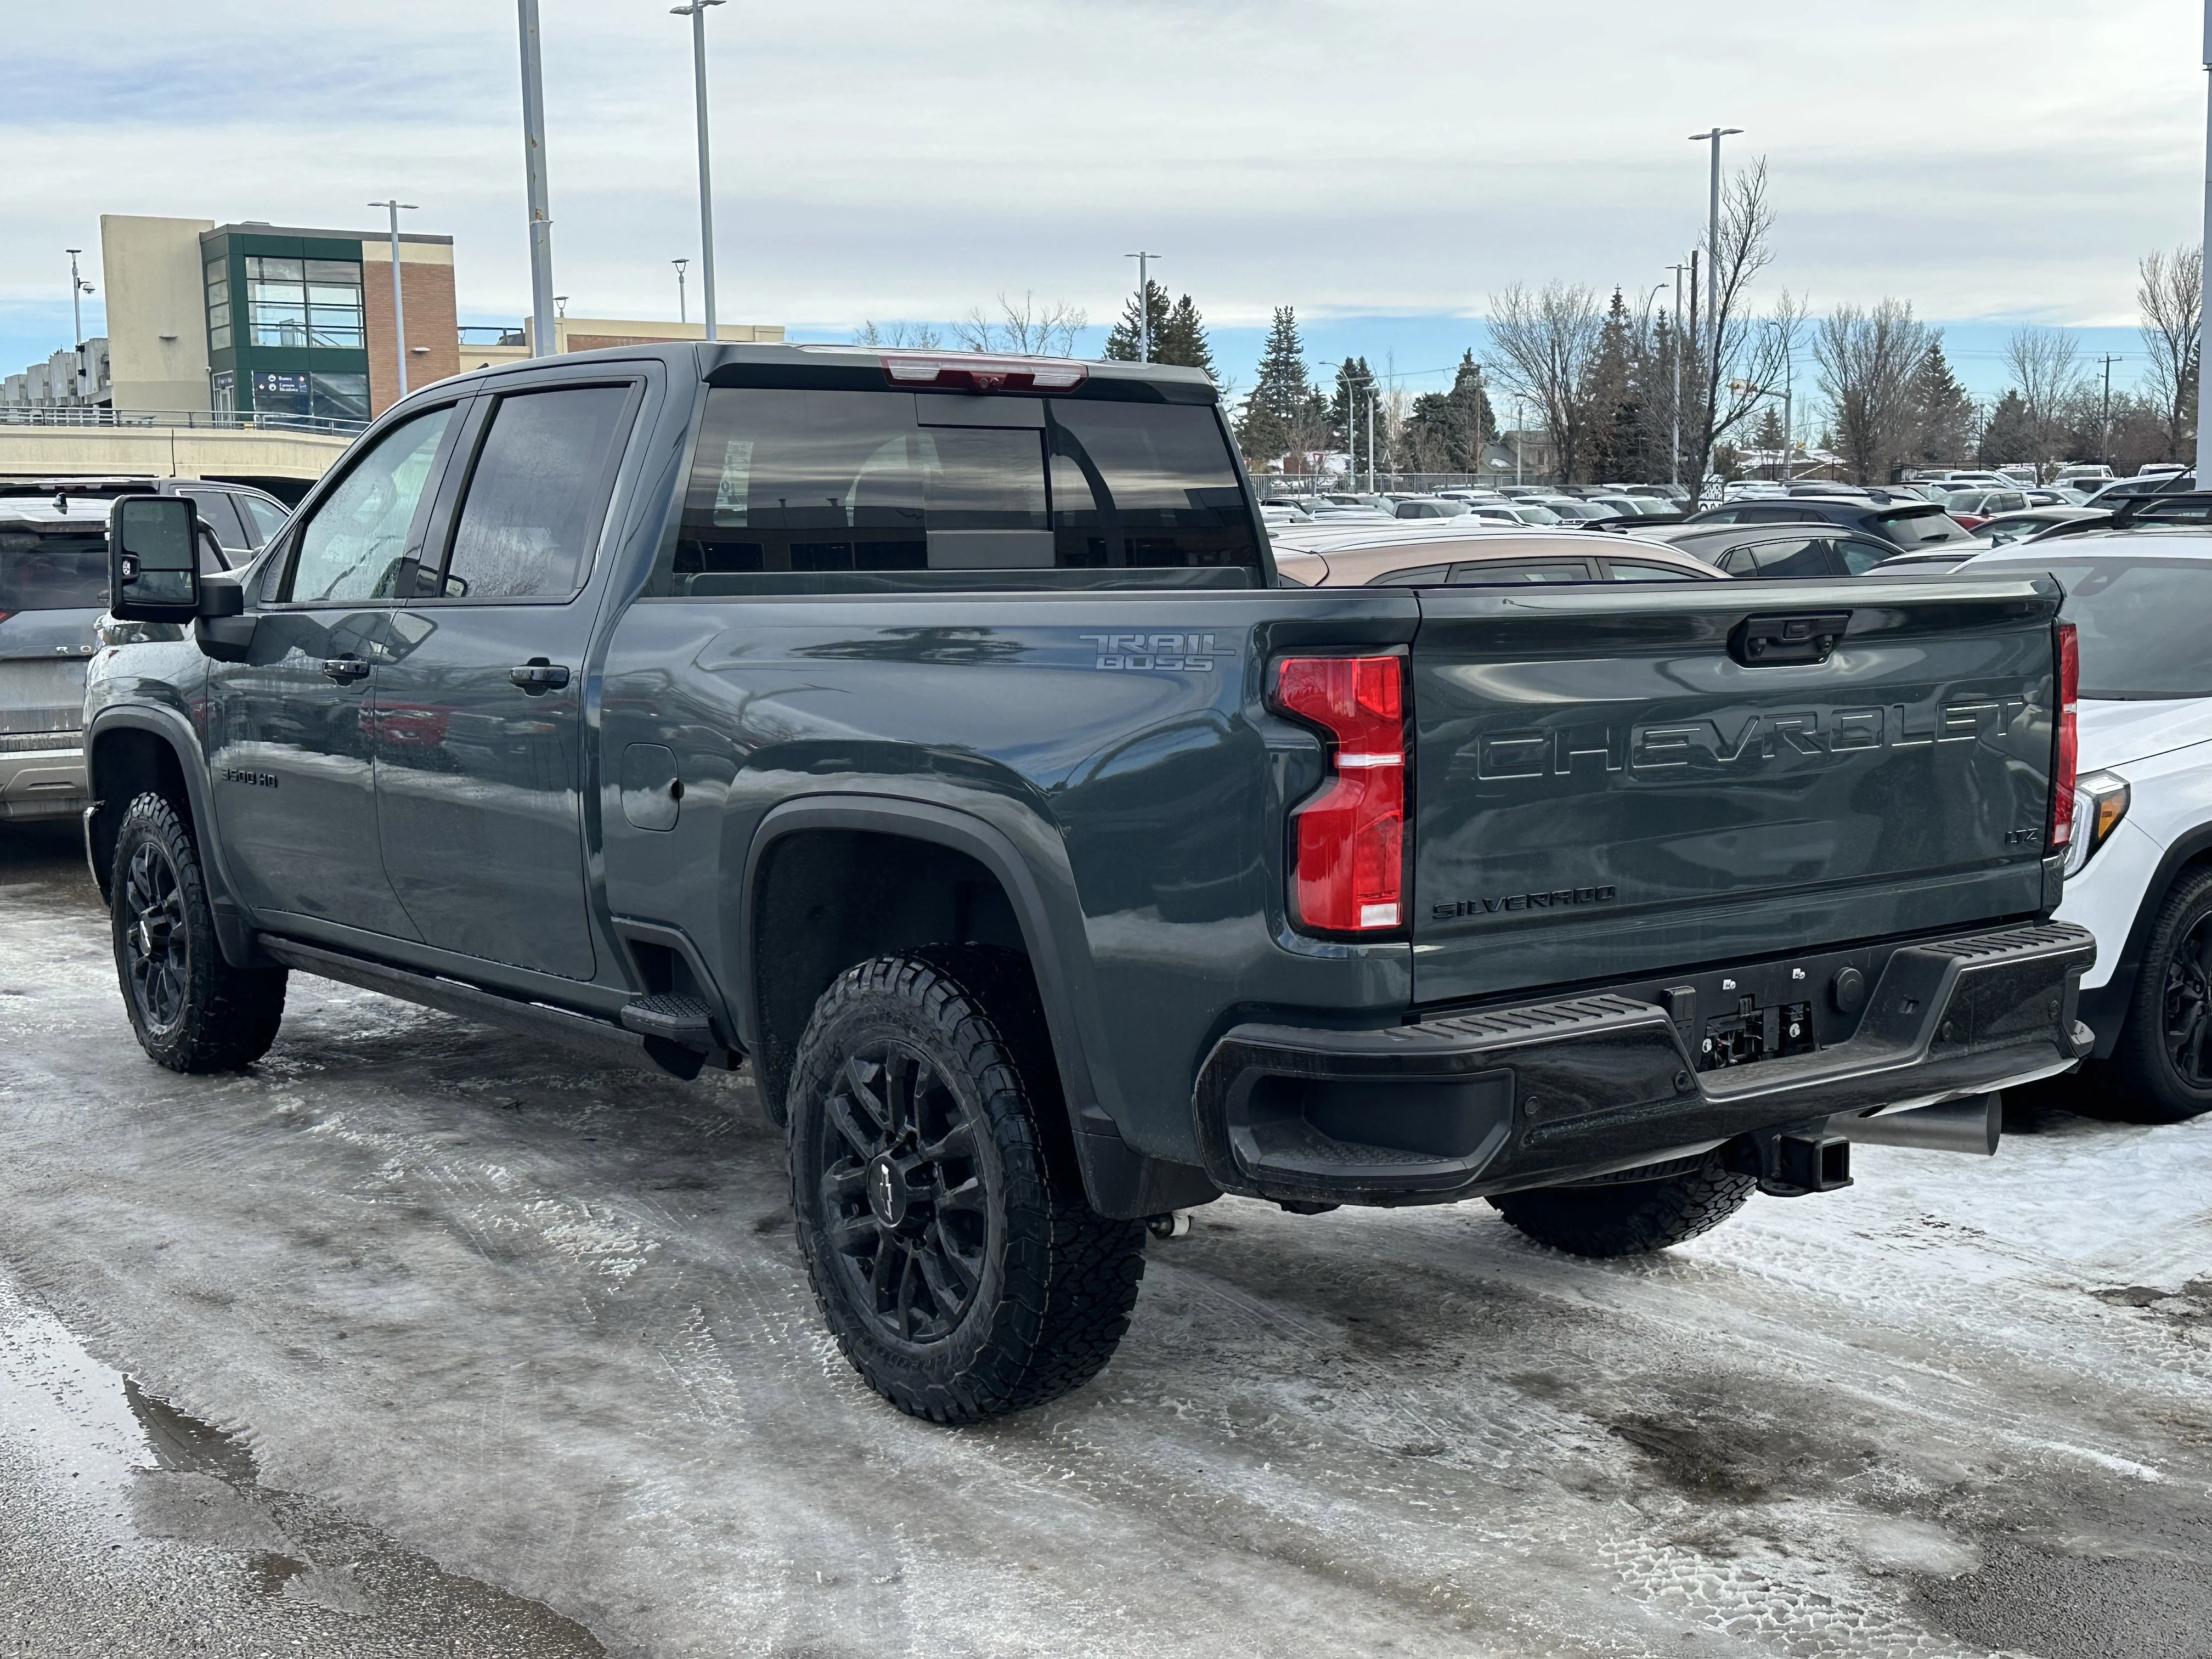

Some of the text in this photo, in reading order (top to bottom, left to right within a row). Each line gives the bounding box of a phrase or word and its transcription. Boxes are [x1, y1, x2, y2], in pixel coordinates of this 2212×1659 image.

[1079, 634, 1236, 656] TRAIL
[1096, 654, 1214, 672] BOSS
[1477, 695, 2024, 780] CHEVROLET
[260, 772, 278, 788] HD
[1432, 884, 1616, 919] SILVERADO
